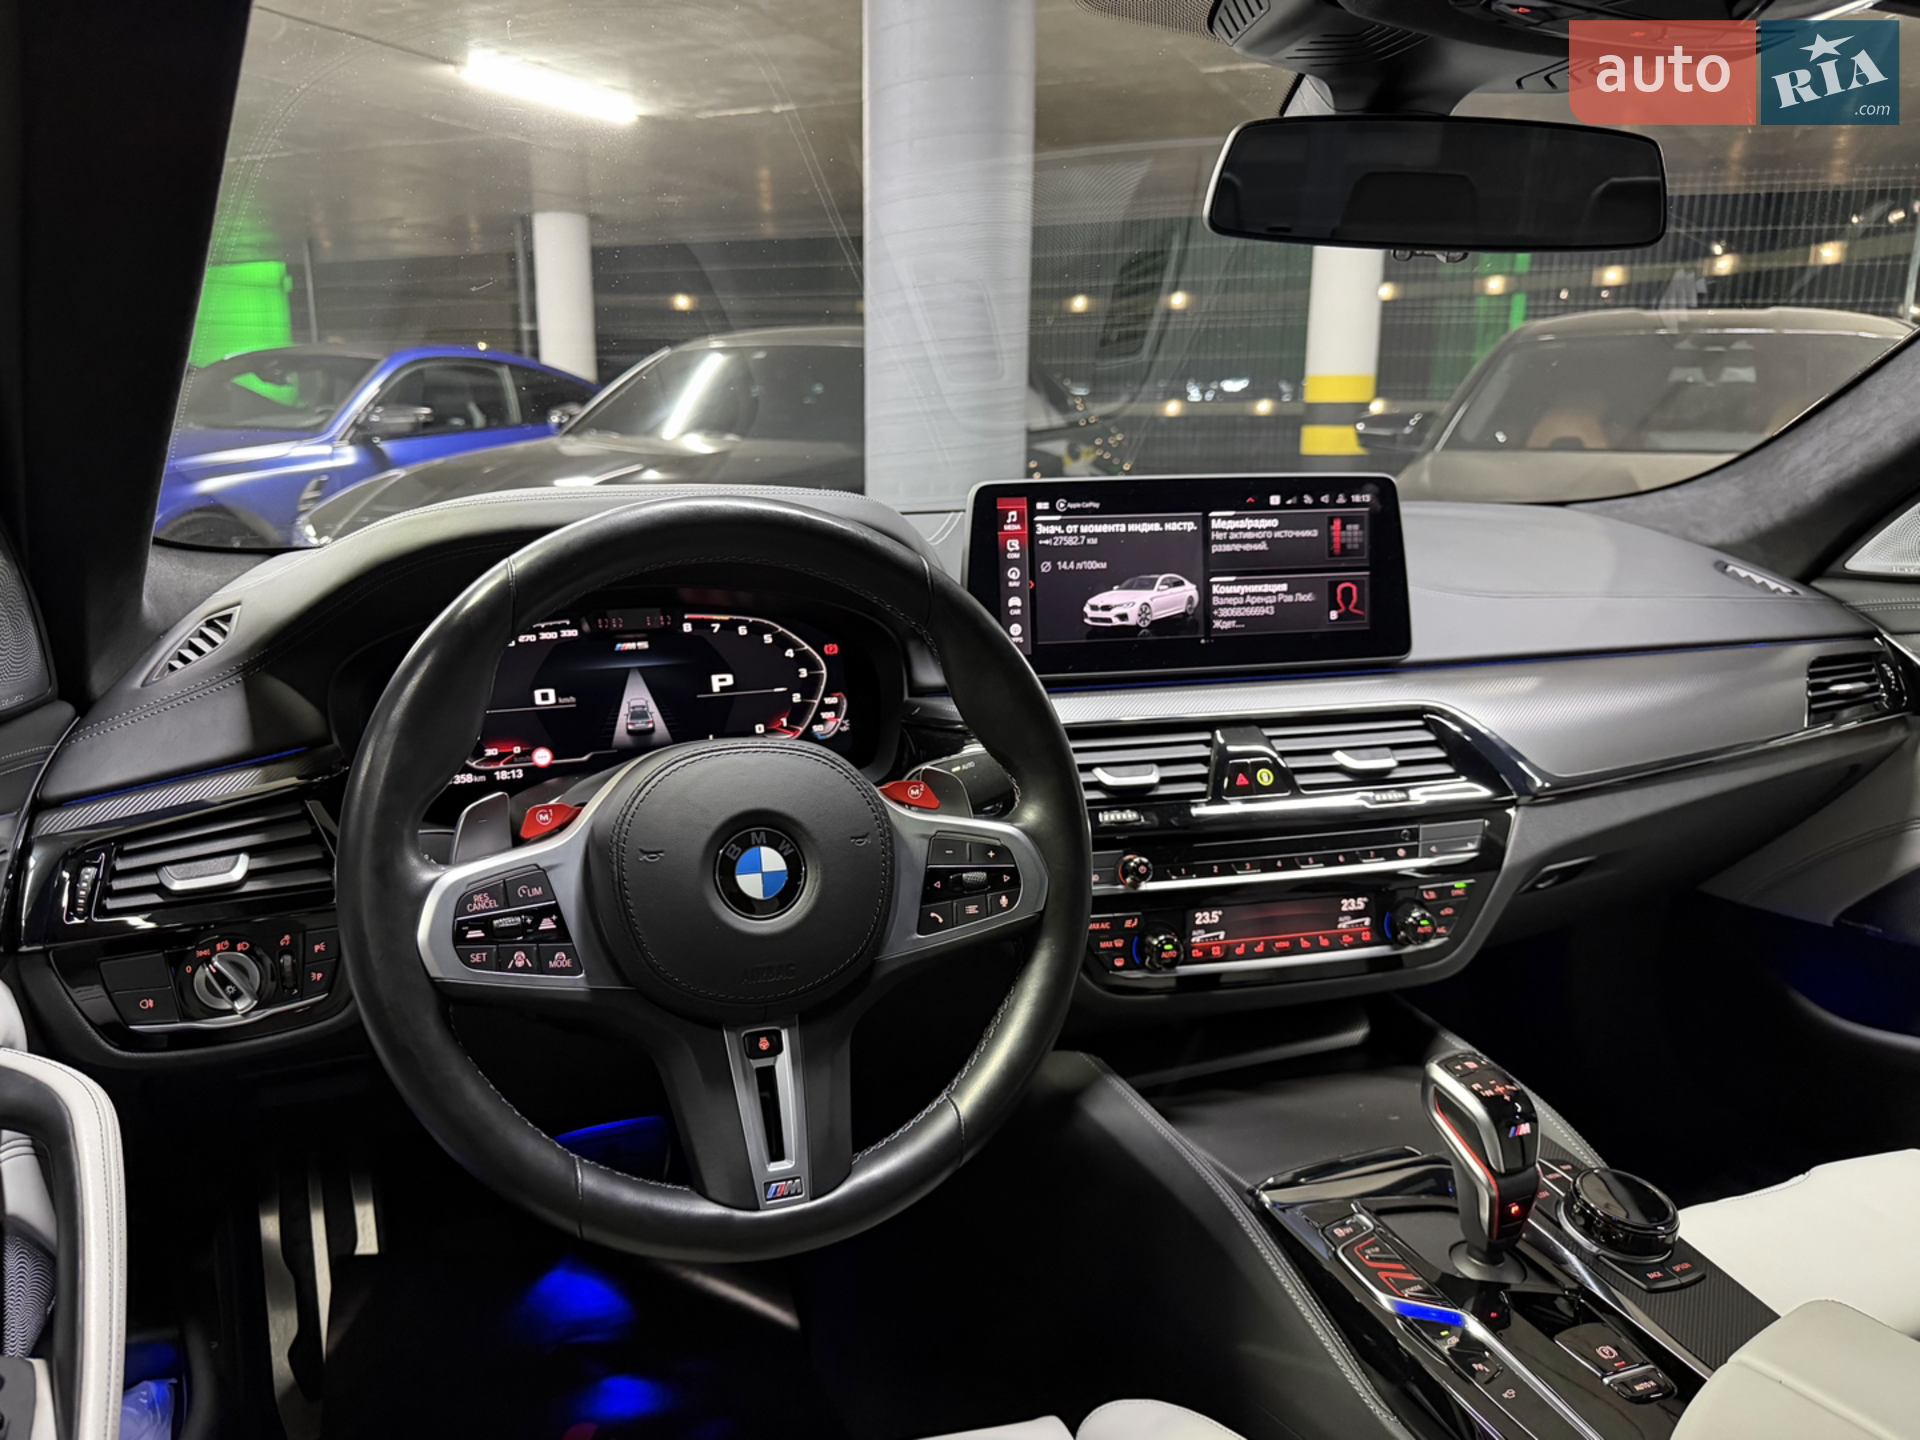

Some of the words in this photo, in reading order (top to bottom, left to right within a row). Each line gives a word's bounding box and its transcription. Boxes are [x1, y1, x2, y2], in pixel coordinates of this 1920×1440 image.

[1351, 494, 1371, 503] 18:13
[1035, 524, 1064, 534] Знач.
[1066, 525, 1078, 534] от
[1080, 523, 1126, 533] момента
[1128, 523, 1163, 534] индив.
[1164, 521, 1197, 532] настр.
[1211, 518, 1279, 530] Медиа/радио
[1211, 531, 1227, 540] Нет
[1229, 531, 1272, 541] активного
[1274, 529, 1318, 538] источника
[1053, 536, 1085, 546] 27582.7
[1087, 537, 1098, 545] км
[1057, 561, 1075, 571] 14.4
[1212, 583, 1288, 595] Коммуникация
[1212, 596, 1244, 606] Валера
[1245, 594, 1277, 606] Аренда
[682, 622, 692, 633] 8
[711, 623, 721, 633] 7
[738, 625, 748, 636] 6
[560, 629, 578, 637] 330
[763, 634, 773, 643] 5
[785, 648, 795, 658] 4
[798, 668, 808, 678] 3
[711, 674, 734, 692] P
[534, 688, 556, 705] 0
[792, 693, 801, 703] 2
[820, 711, 835, 719] 100
[781, 717, 788, 727] 1
[755, 724, 765, 734] 0
[484, 748, 498, 757] 30
[513, 746, 521, 754] 0
[494, 769, 524, 780] 18:13
[725, 831, 794, 861] BMW
[527, 886, 543, 897] LIM
[473, 893, 489, 901] RES
[467, 899, 499, 912] CANCEL
[470, 952, 487, 963] SET
[549, 959, 572, 969] MODE
[1646, 1271, 1664, 1280] BACK
